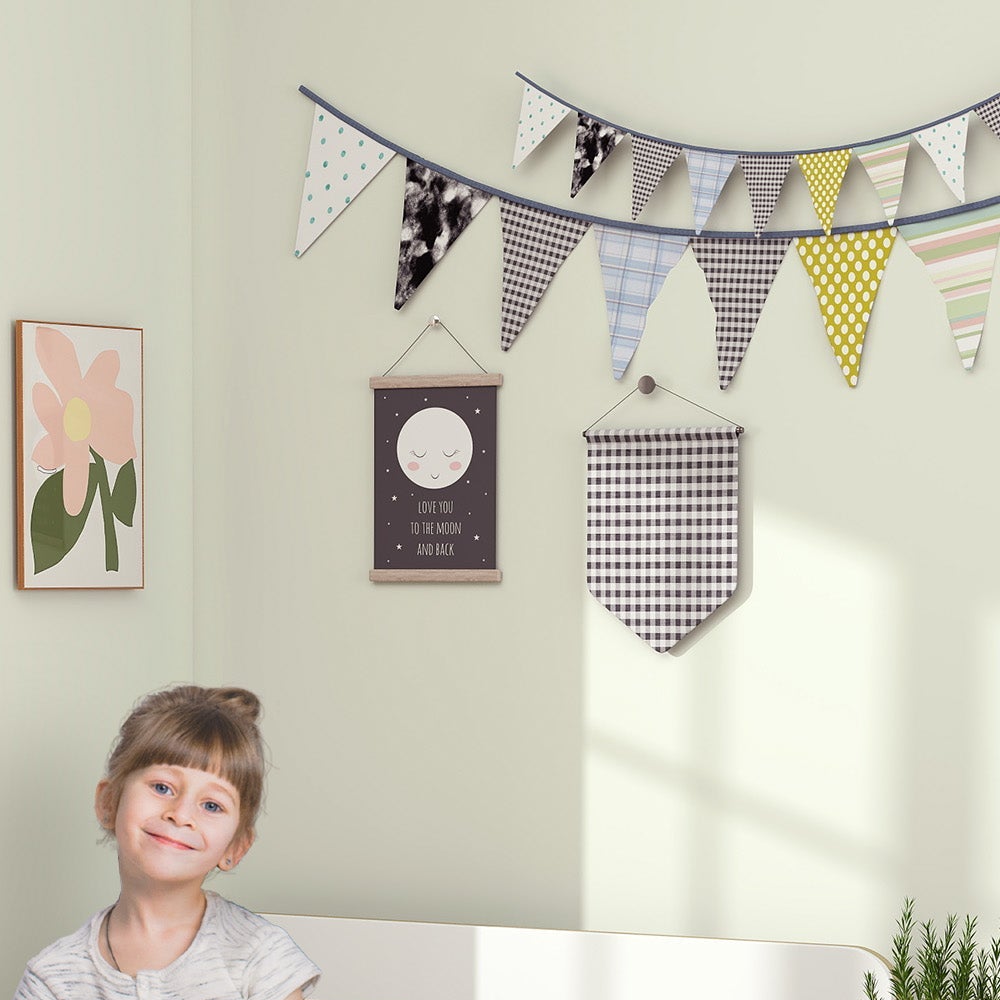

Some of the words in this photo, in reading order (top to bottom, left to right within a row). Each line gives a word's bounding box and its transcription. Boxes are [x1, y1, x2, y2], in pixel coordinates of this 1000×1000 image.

[418, 501, 436, 514] LOVE
[438, 501, 454, 514] YOU
[410, 522, 420, 535] TO
[422, 522, 434, 535] THE
[436, 522, 462, 535] MOON
[417, 543, 434, 556] AND
[435, 543, 455, 556] BACK
